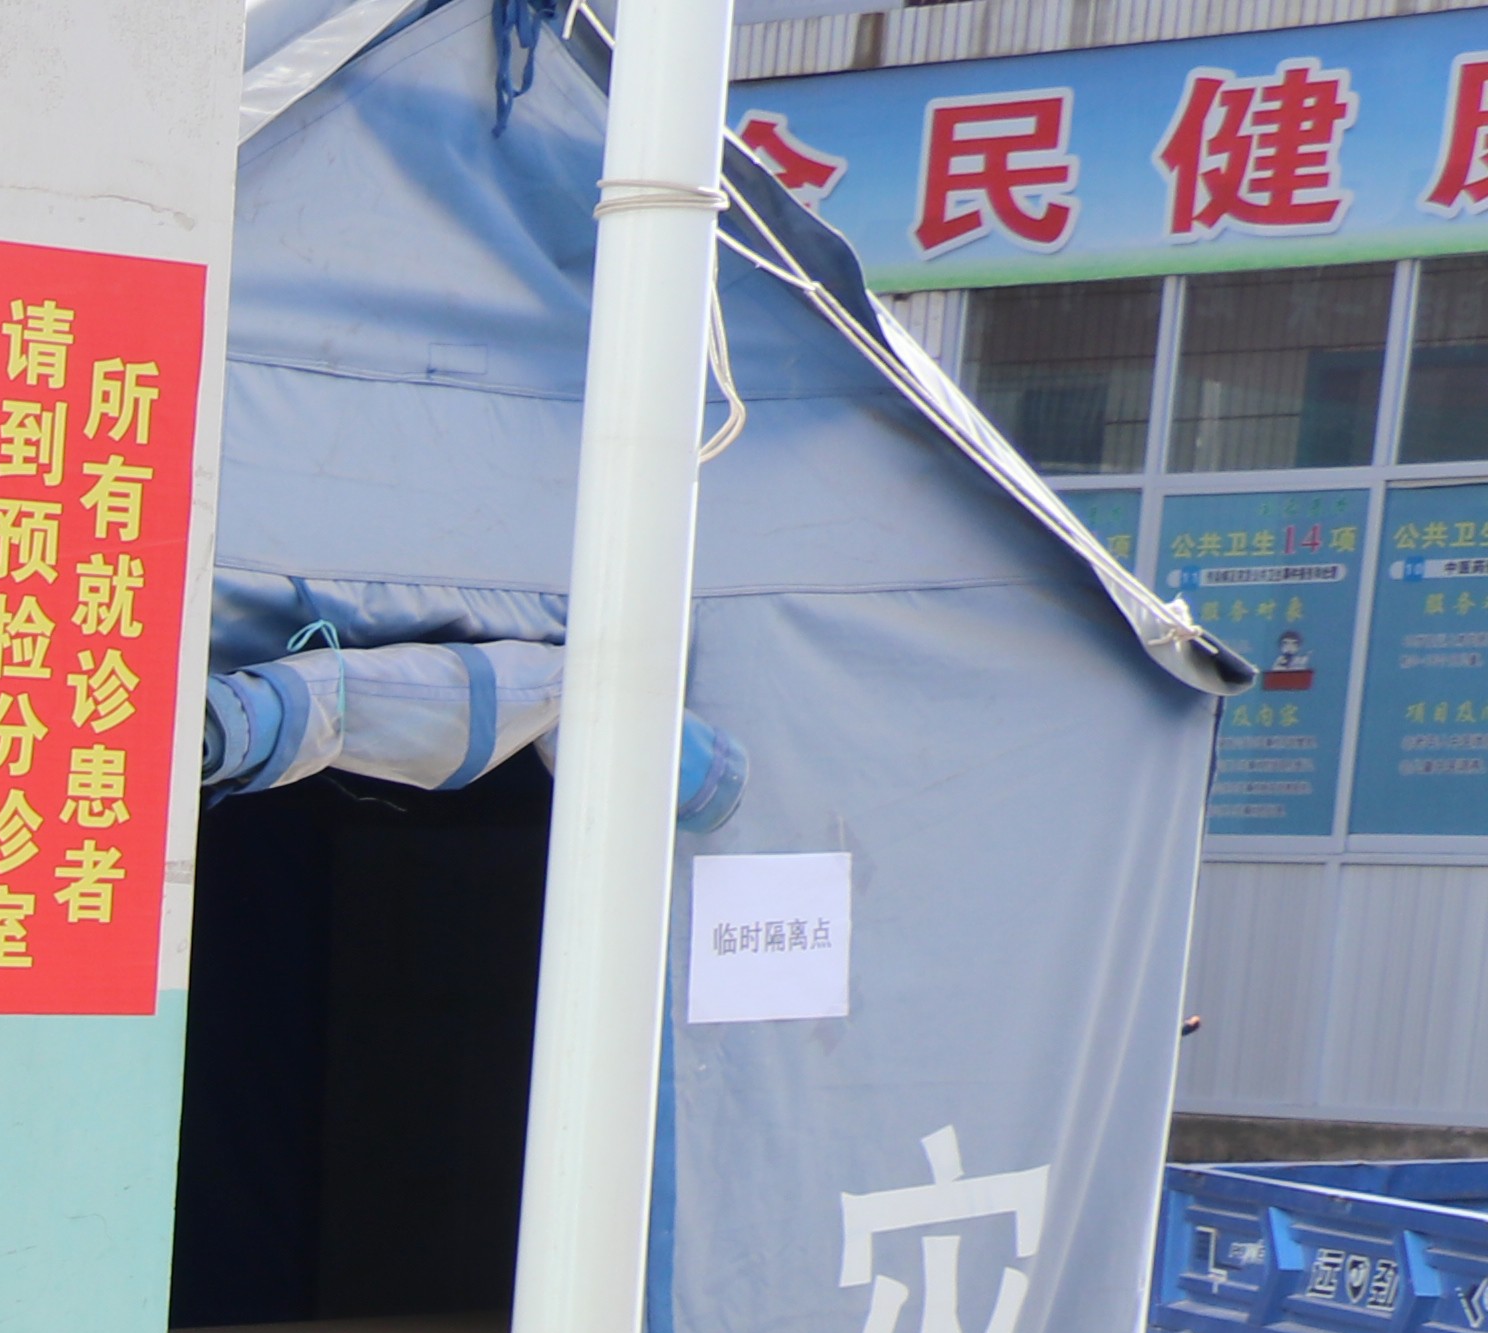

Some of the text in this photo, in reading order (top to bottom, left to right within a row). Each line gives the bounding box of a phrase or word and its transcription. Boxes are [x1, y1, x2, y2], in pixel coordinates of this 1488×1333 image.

[1444, 559, 1488, 575] 中医药
[54, 357, 161, 925] 所有就诊患者
[712, 917, 833, 957] 临时隔离点
